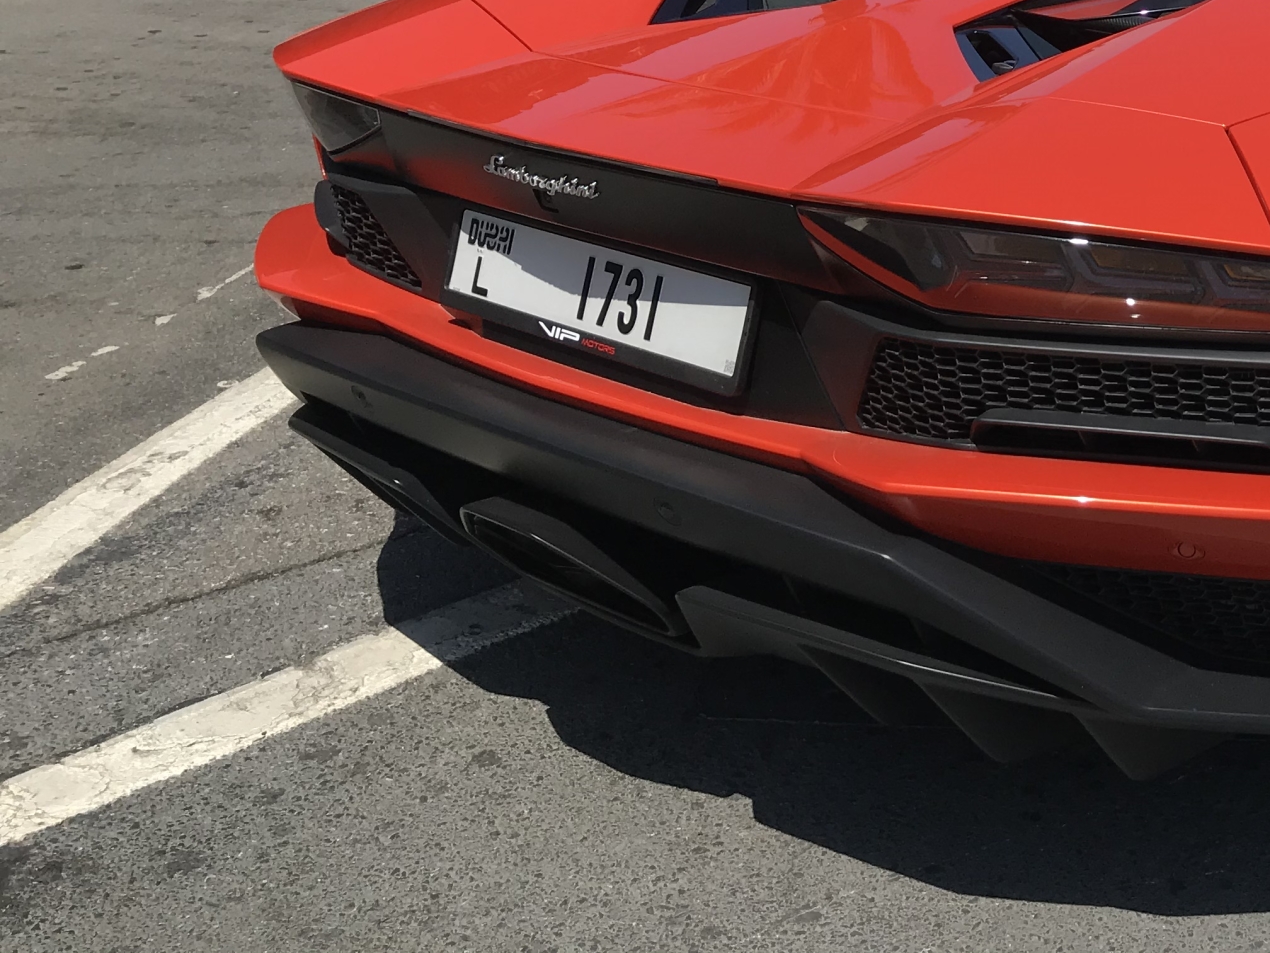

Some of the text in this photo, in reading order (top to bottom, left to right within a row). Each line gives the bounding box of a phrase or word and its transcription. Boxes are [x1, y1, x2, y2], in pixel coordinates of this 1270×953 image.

[483, 155, 600, 199] Lamborghini
[471, 256, 664, 341] L 1731
[538, 320, 615, 355] VIP MOTORS
